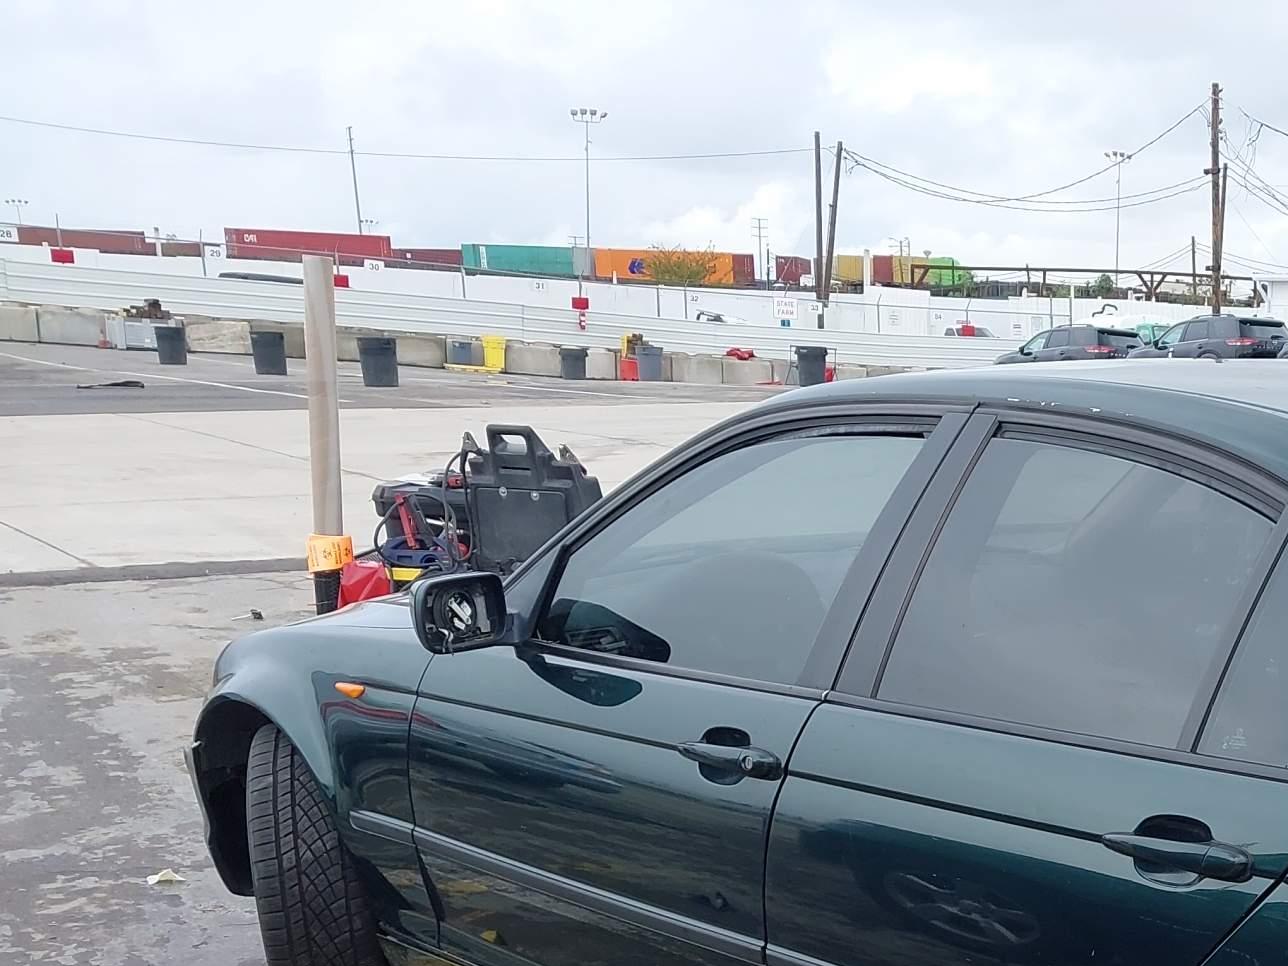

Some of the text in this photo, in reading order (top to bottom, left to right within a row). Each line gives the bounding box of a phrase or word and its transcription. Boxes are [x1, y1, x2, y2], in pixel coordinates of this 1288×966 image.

[210, 249, 221, 257] 29
[368, 262, 380, 271] 30
[535, 282, 545, 290] 31
[690, 295, 699, 303] 32
